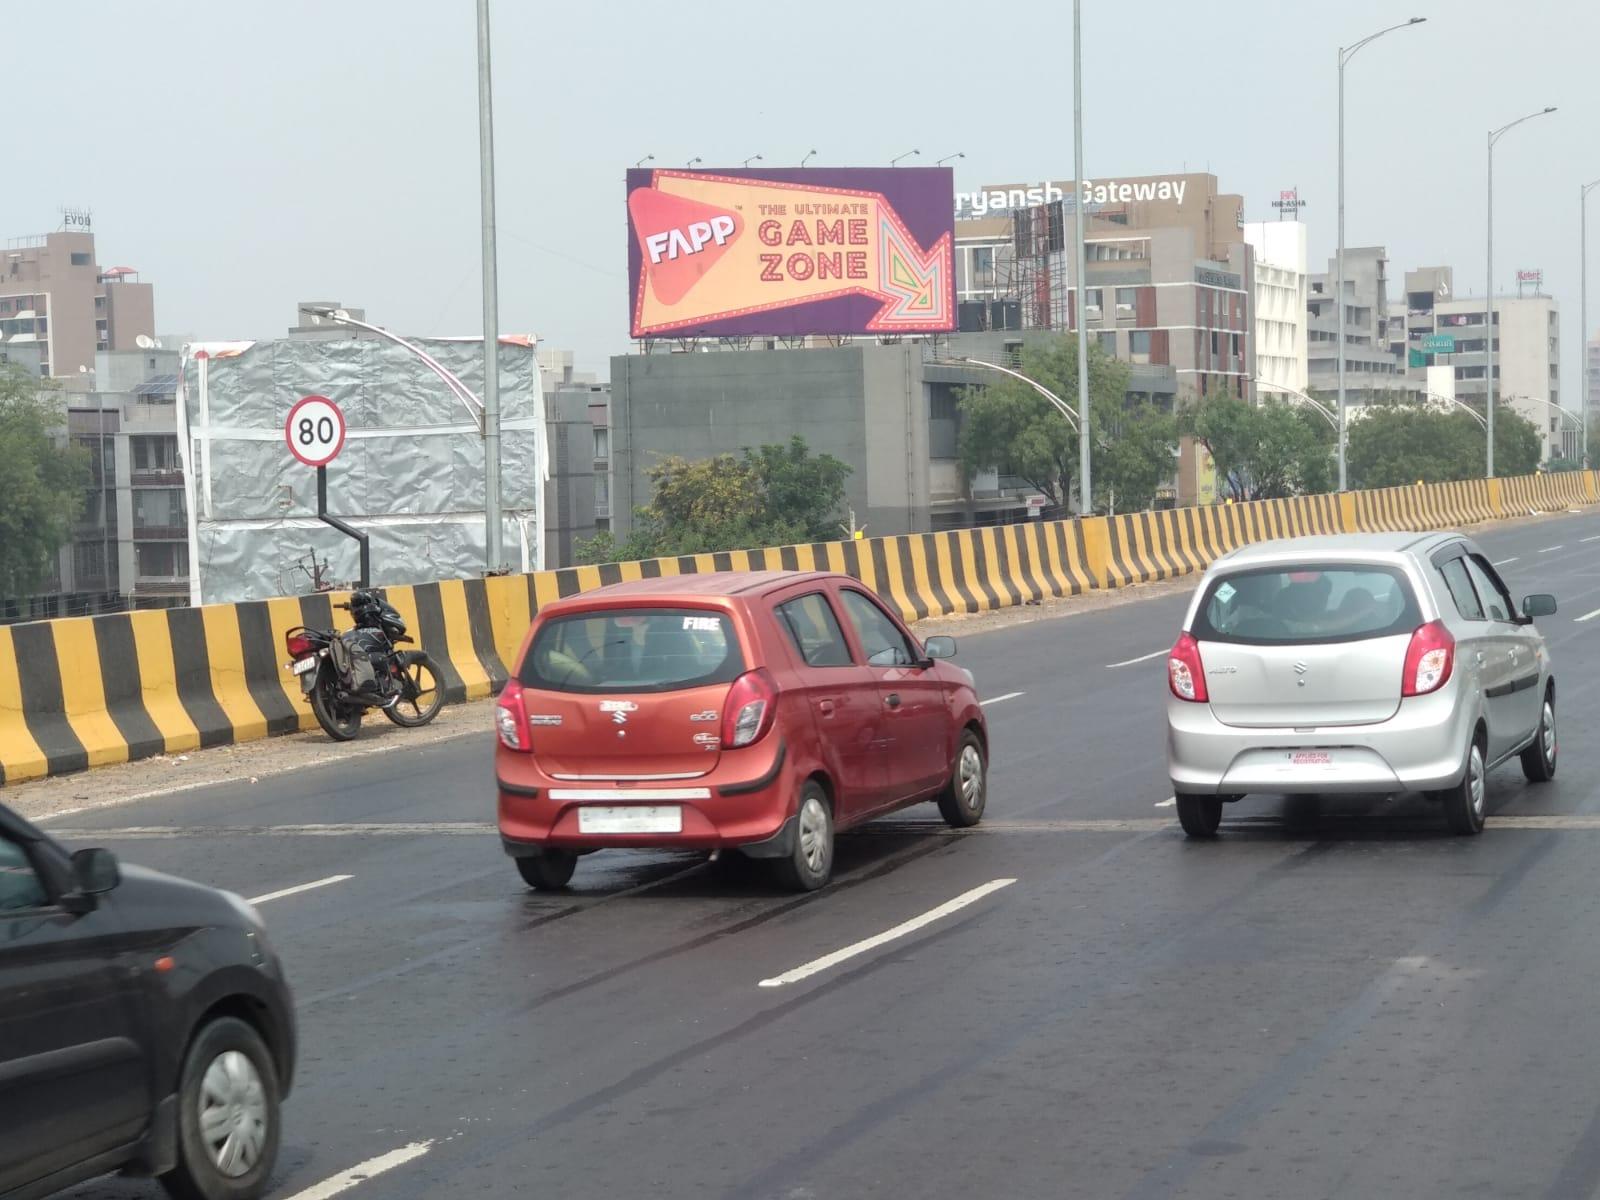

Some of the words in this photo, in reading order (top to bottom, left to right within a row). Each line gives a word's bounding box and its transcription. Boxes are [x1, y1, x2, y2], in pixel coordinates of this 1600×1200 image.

[1081, 180, 1186, 205] Gateway
[758, 204, 787, 216] THE
[794, 203, 869, 215] ULTIMATE
[645, 215, 735, 264] FAPP
[758, 218, 868, 247] GAME
[759, 251, 868, 281] ZONE
[299, 416, 333, 445] 80
